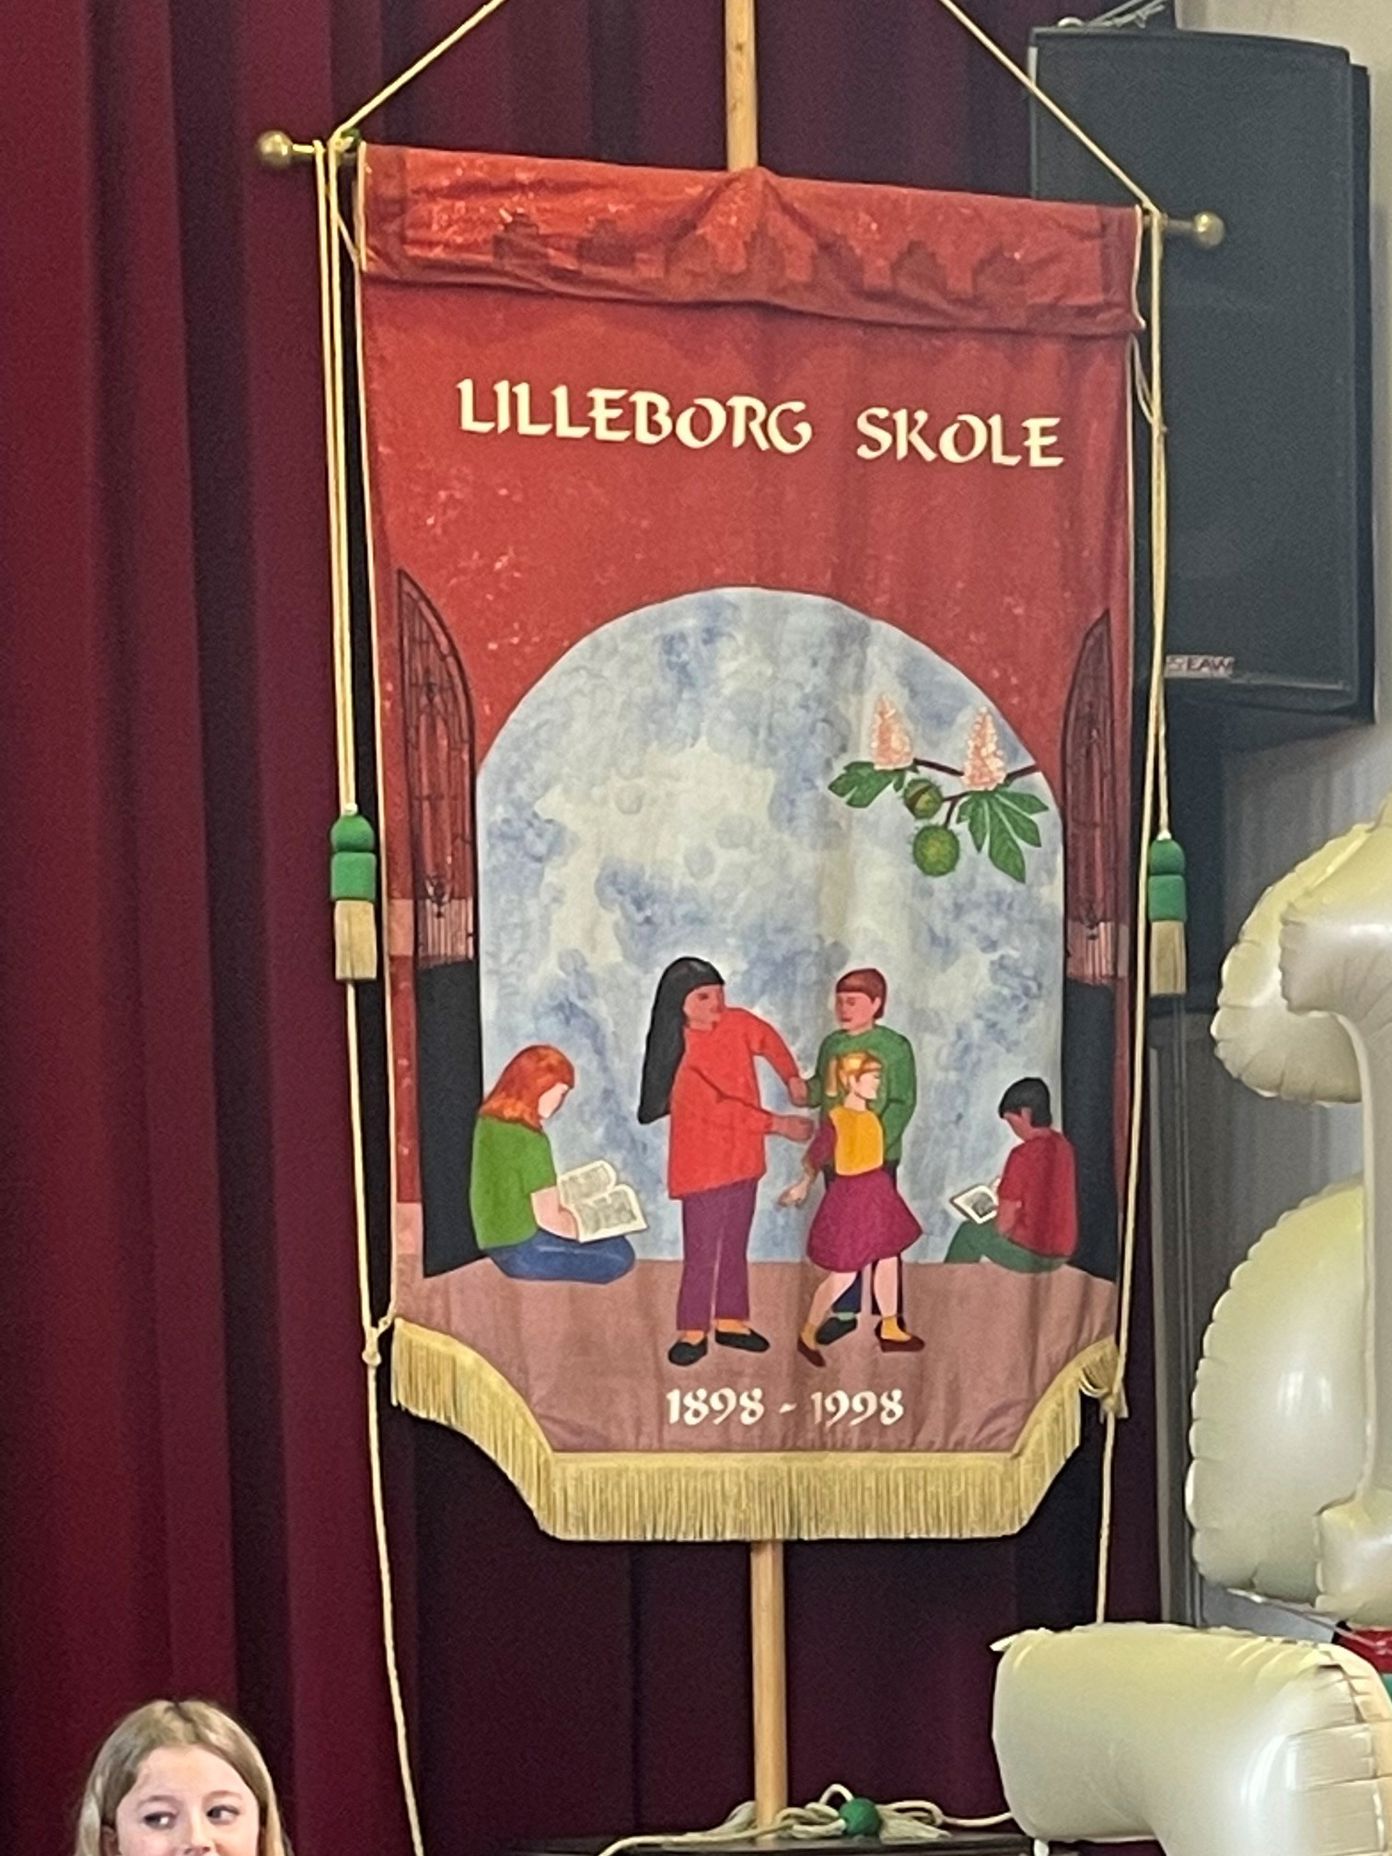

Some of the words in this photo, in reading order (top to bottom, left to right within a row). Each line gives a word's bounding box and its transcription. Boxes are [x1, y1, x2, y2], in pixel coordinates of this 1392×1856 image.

[457, 377, 813, 455] LILLEBORG
[856, 406, 1065, 468] SKOLE
[665, 1386, 765, 1427] 1898
[810, 1387, 905, 1429] 1998
